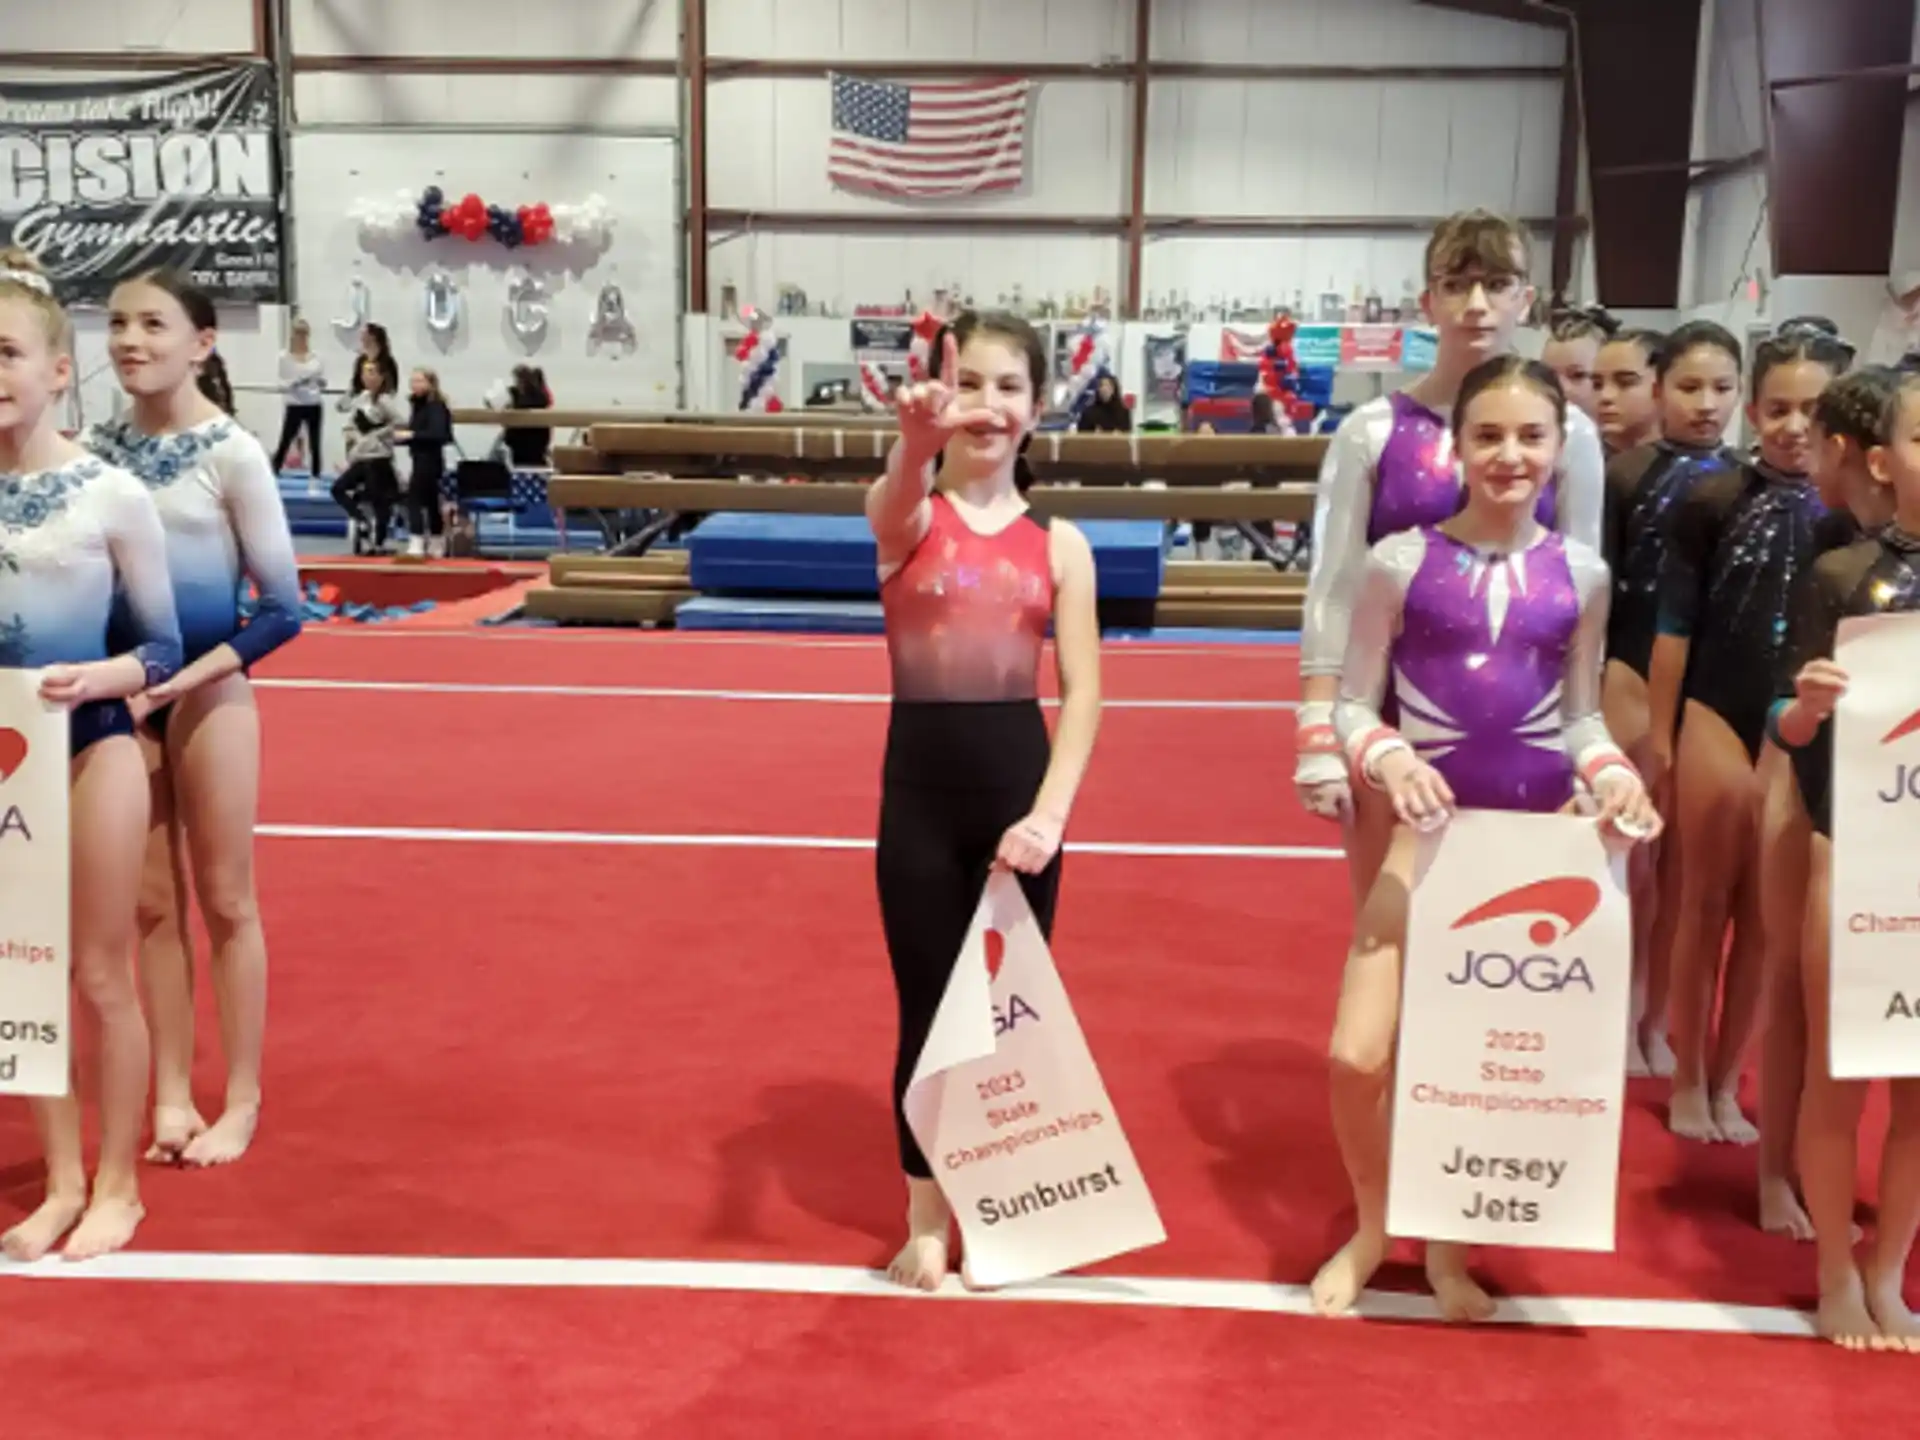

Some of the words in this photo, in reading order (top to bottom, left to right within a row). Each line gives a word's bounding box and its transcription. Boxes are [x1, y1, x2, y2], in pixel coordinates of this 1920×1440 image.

[1446, 950, 1595, 993] JOGA
[1485, 1029, 1546, 1052] 2023
[975, 1070, 1027, 1101] 2023
[1480, 1061, 1546, 1084] State
[985, 1099, 1040, 1129] State
[1409, 1083, 1608, 1117] Championships
[943, 1108, 1105, 1171] Championships
[1442, 1147, 1568, 1189] Jersey
[975, 1161, 1122, 1226] Sunburst
[1461, 1191, 1541, 1223] Jets
